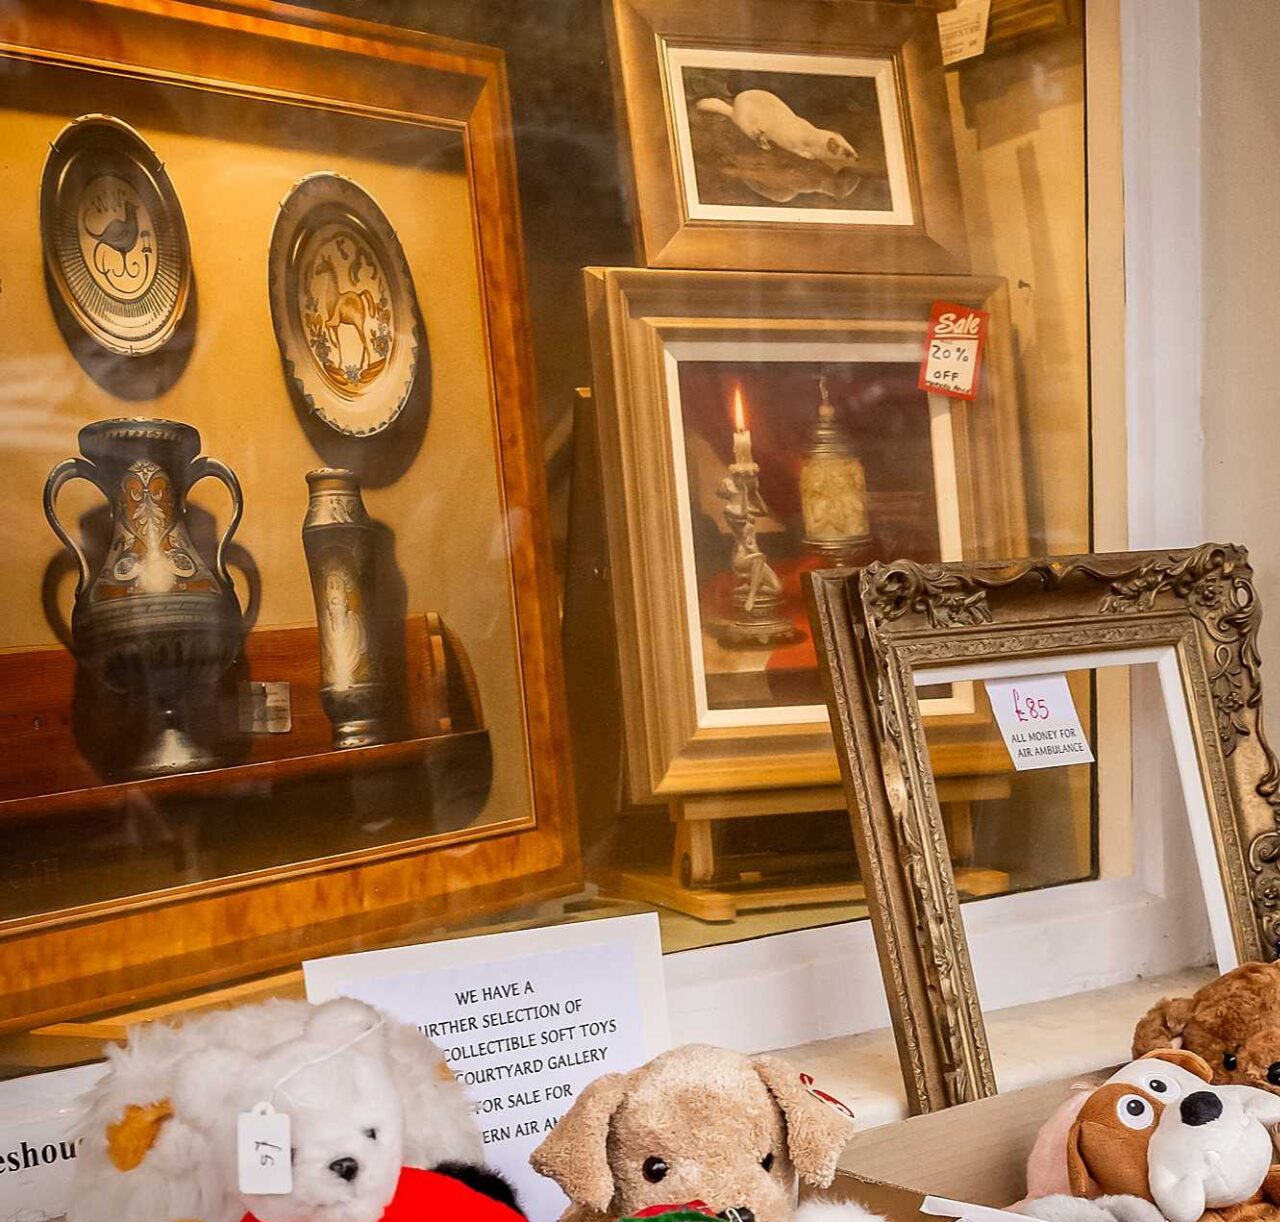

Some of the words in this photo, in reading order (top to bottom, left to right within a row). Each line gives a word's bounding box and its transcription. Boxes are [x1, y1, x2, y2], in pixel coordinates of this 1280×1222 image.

[934, 312, 981, 335] Sale
[933, 371, 959, 381] OFF
[1013, 689, 1049, 722] £85
[1012, 733, 1027, 743] ALL
[1028, 730, 1058, 741] MONEY
[1060, 728, 1076, 739] FOR
[1018, 747, 1033, 758] AIR
[1035, 742, 1084, 757] AMBULANCE
[454, 990, 479, 1006] WE
[482, 983, 520, 1002] HAVE
[523, 981, 534, 994] A
[482, 1002, 560, 1030] SELECTION
[564, 998, 583, 1014] OF
[540, 1026, 576, 1046] SOFT
[579, 1018, 617, 1038] TOYS
[547, 1046, 608, 1071] GALLERY
[507, 1090, 540, 1109] SALE
[545, 1083, 573, 1100] FOR
[515, 1120, 540, 1137] AIR
